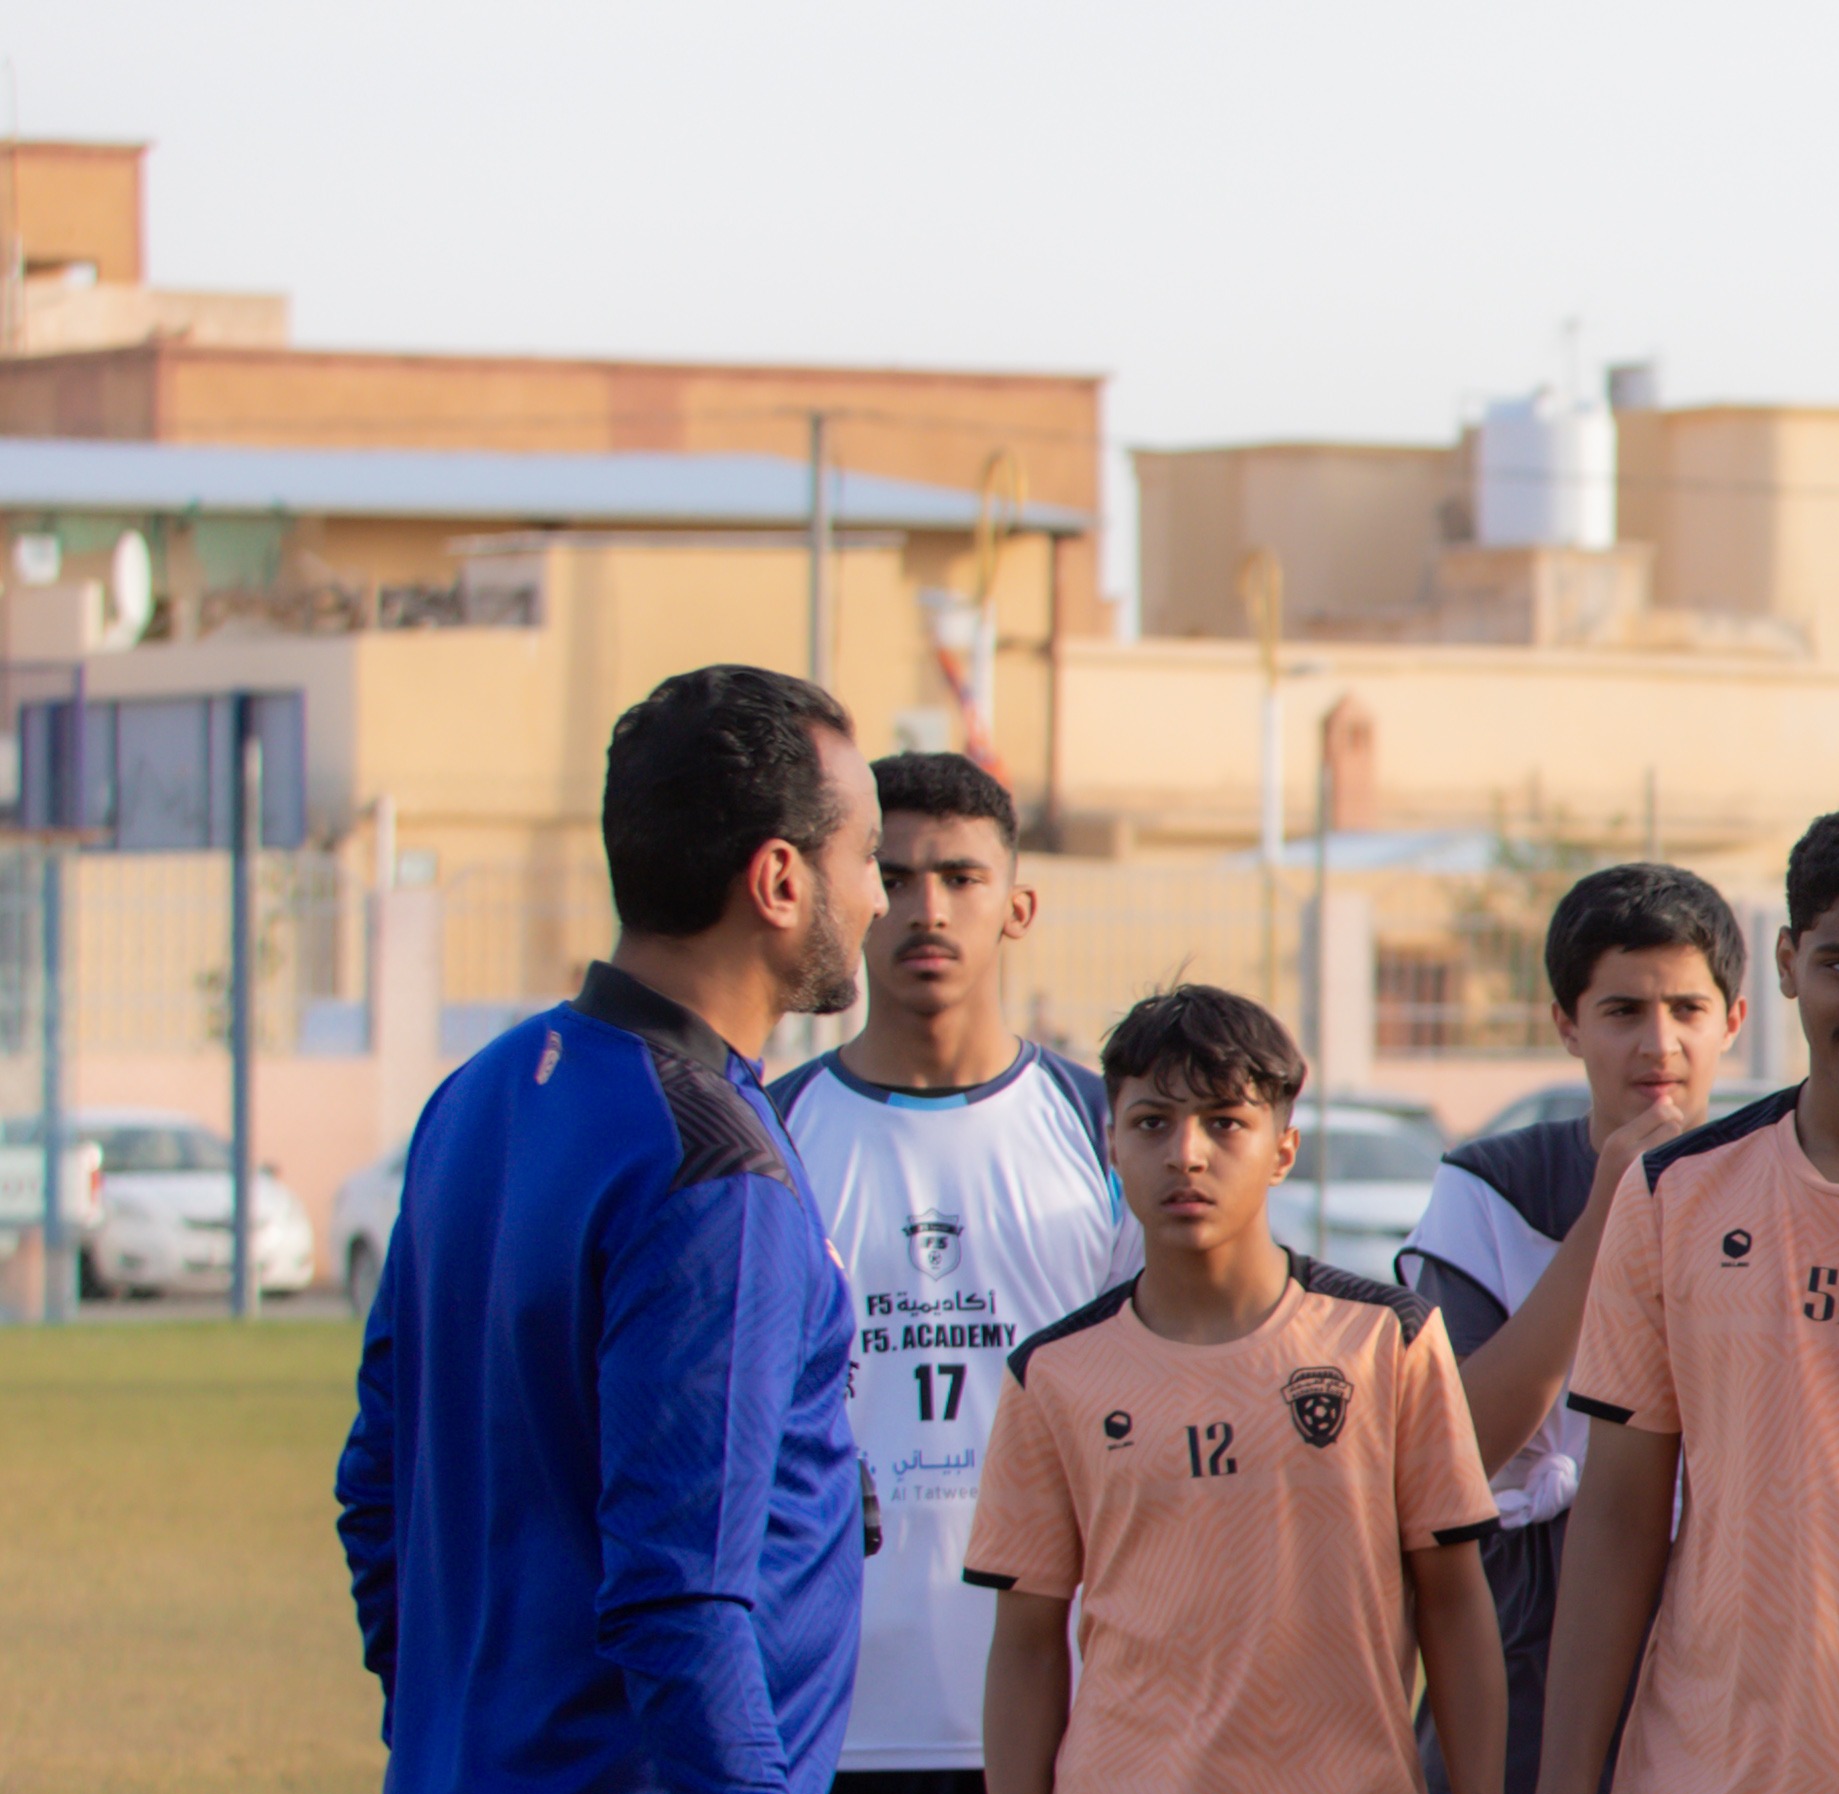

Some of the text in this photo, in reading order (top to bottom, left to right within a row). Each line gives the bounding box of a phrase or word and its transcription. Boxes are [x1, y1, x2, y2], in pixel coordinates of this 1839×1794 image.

[866, 1289, 996, 1316] أكاديمية F5
[902, 1323, 1016, 1350] ACADEMY
[914, 1363, 968, 1422] 17
[1185, 1421, 1237, 1478] 12
[914, 1485, 979, 1500] Tatwee
